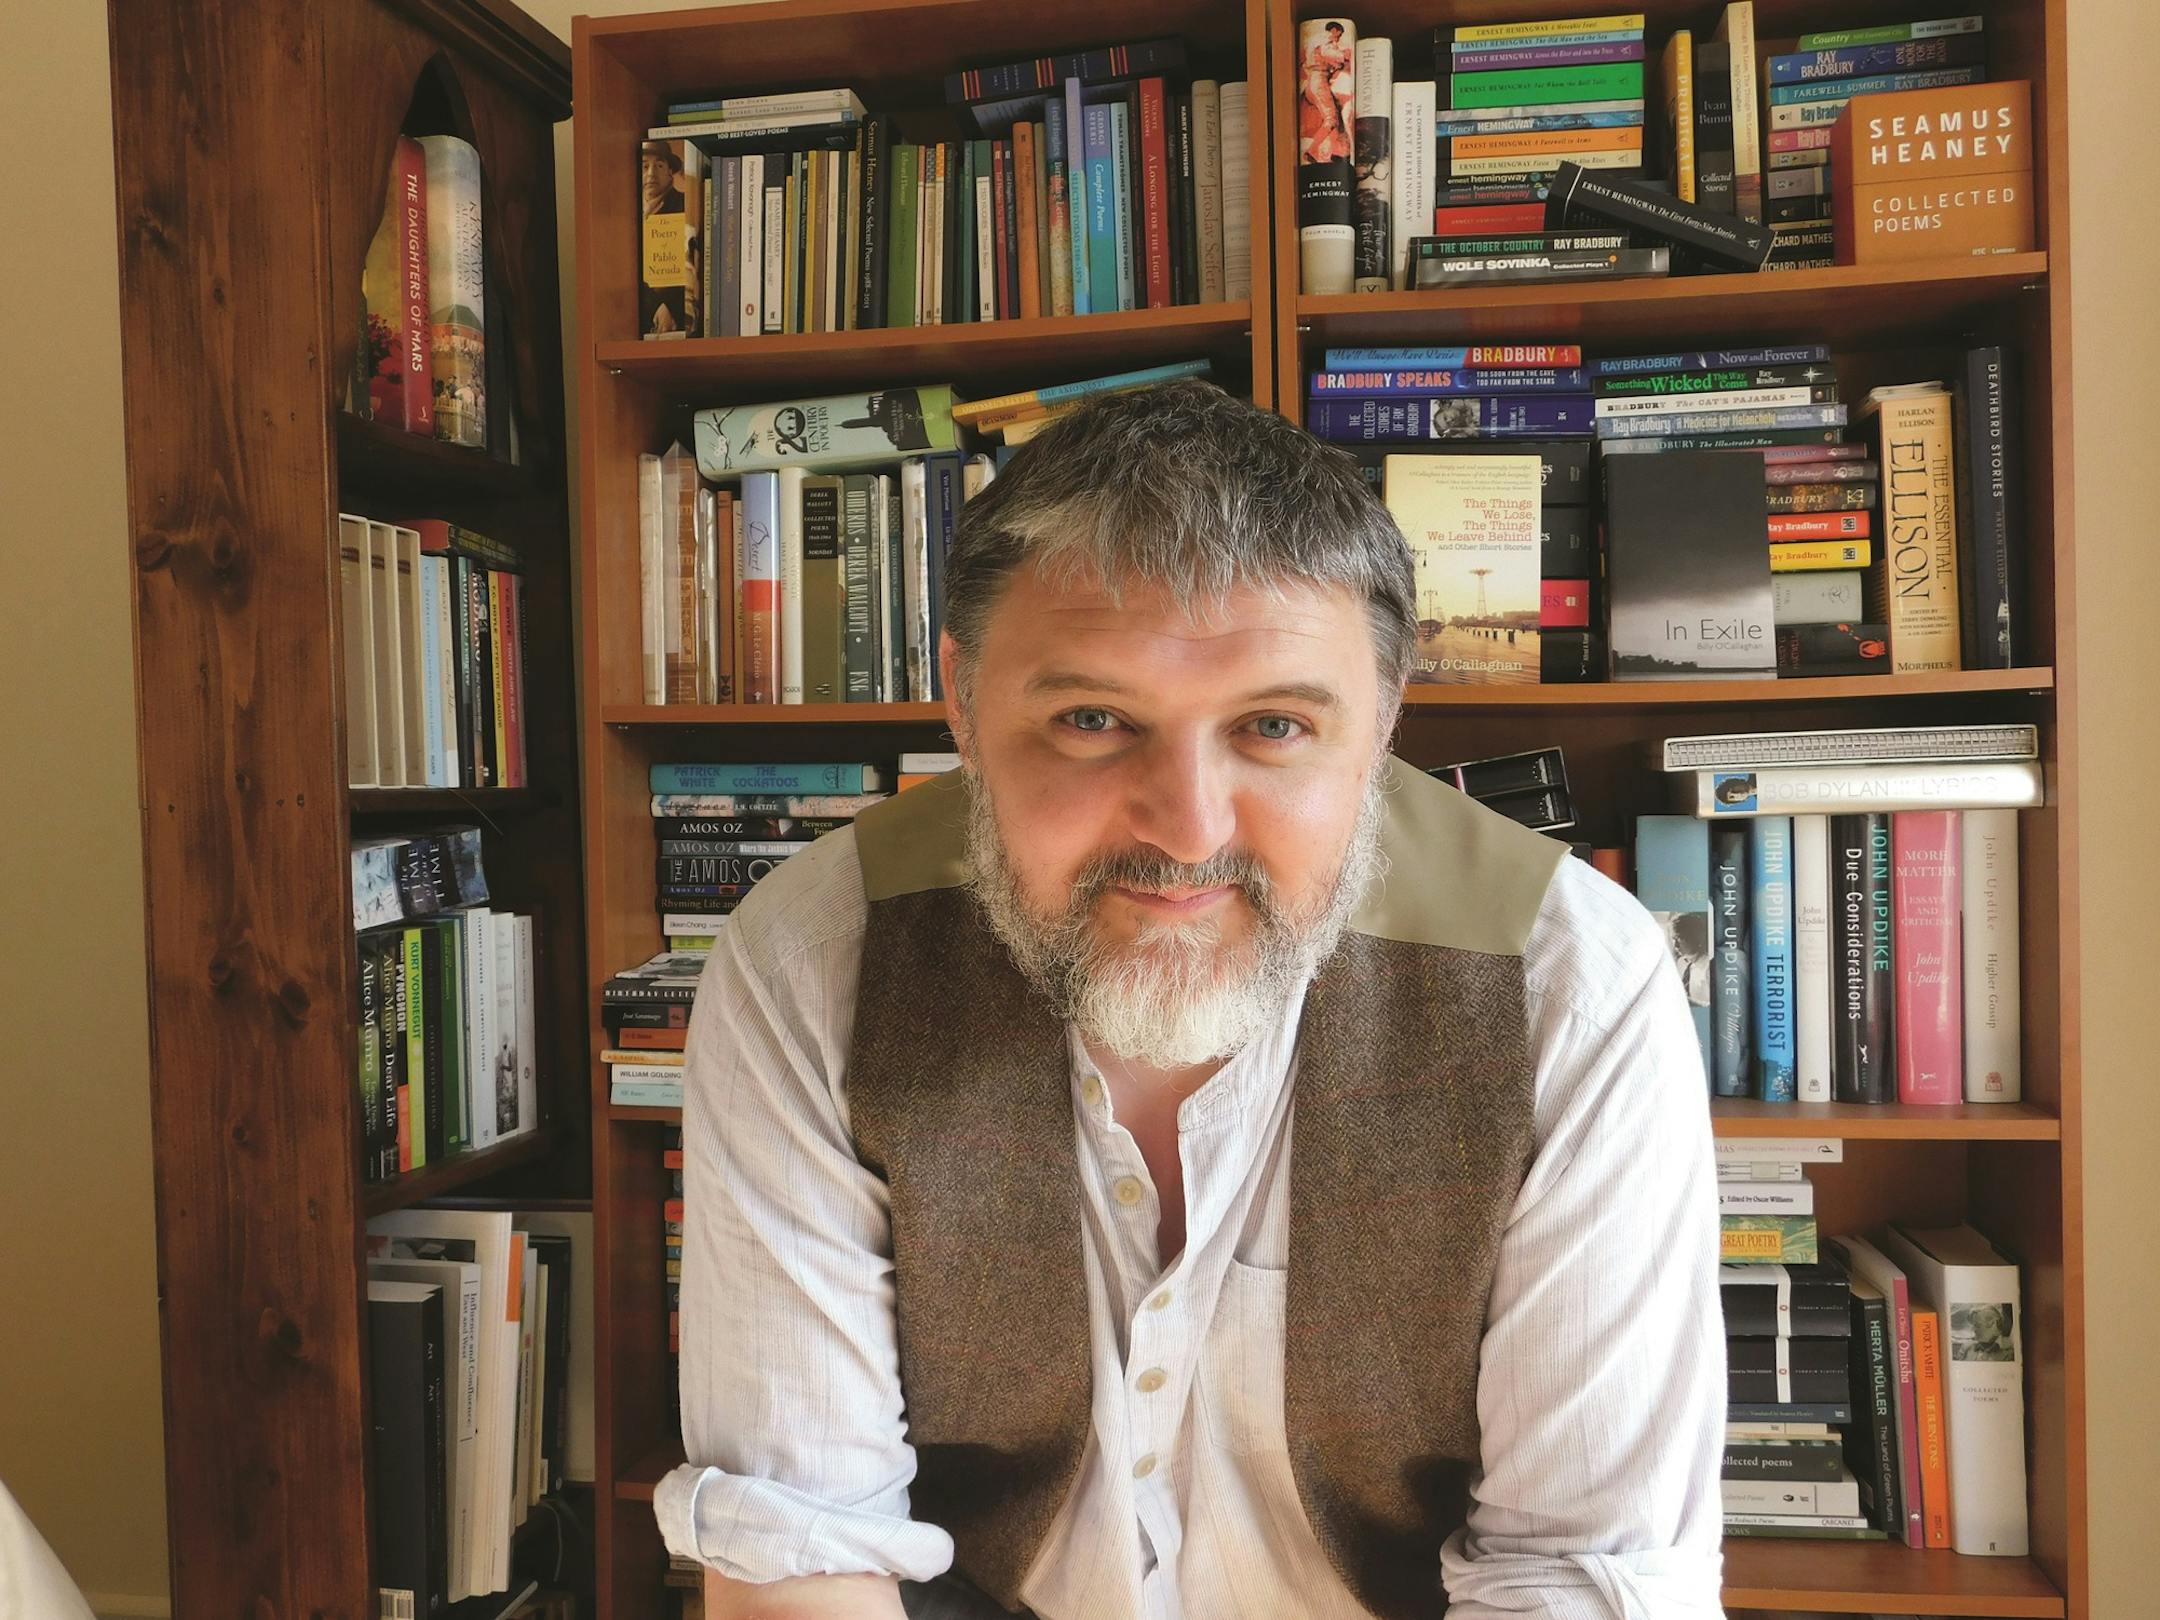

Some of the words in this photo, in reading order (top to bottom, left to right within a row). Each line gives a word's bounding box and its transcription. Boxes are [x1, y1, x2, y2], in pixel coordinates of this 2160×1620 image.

[1506, 24, 1548, 36] HEMINGWAY
[1812, 32, 1850, 46] Country
[1460, 41, 1488, 50] ERNEST
[1490, 38, 1533, 47] HEMINGWAY
[1560, 35, 1574, 43] Man
[1574, 34, 1586, 42] and
[1460, 55, 1488, 64] ERNEST
[1489, 52, 1534, 62] HEMINGWAY
[1816, 50, 1836, 64] RAY
[1895, 46, 1904, 65] ONE
[1800, 60, 1854, 78] BRADBURY
[1360, 50, 1376, 114] HEMINGWAY
[1460, 86, 1488, 94] ERNEST
[1792, 85, 1842, 98] FAREWELL
[1846, 80, 1887, 94] SUMMER
[1894, 78, 1914, 90] RAY
[1917, 72, 1973, 88] BRADBURY
[1703, 100, 1726, 112] Ivan
[1800, 106, 1816, 122] Ray
[767, 127, 789, 136] POEMS
[1477, 119, 1534, 132] HEMINGWAY
[1869, 106, 2012, 138] SEAMUS
[1460, 142, 1488, 150] ERNEST
[1488, 140, 1533, 149] HEMINGWAY
[1540, 138, 1566, 146] Farewell
[1872, 134, 2012, 165] HEANEY
[1148, 154, 1157, 162] A
[1459, 162, 1488, 170] ERNEST
[1488, 160, 1530, 169] HEMINGWAY
[407, 173, 418, 202] THE
[1150, 164, 1158, 208] LONGING
[1310, 180, 1342, 189] ERNEST
[1405, 150, 1414, 222] HEMINGWAY
[1470, 172, 1528, 186] hemingway
[1704, 184, 1728, 192] Stories
[866, 196, 874, 214] New
[1200, 182, 1218, 238] Jaroslav
[1582, 180, 1611, 196] ERNEST
[1612, 190, 1657, 214] HEMINGWAY
[1670, 210, 1684, 224] First
[1715, 226, 1736, 240] Stories
[1874, 188, 2015, 214] COLLECTED
[865, 215, 874, 246] Selected
[1150, 211, 1159, 230] FOR
[1874, 214, 1942, 234] POEMS
[1151, 234, 1159, 251] THE
[1440, 242, 1458, 254] THE
[1459, 240, 1500, 252] OCTOBER
[1502, 239, 1544, 251] COUNTRY
[1553, 238, 1572, 250] RAY
[1574, 236, 1622, 248] BRADBURY
[408, 207, 421, 300] DAUGHTERS
[1204, 242, 1222, 291] Seifert
[1442, 260, 1485, 272] WOLE
[410, 305, 422, 328] OF
[410, 329, 423, 372] MARS
[1472, 348, 1557, 364] BRADBURY
[1718, 353, 1748, 364] Now
[1748, 354, 1764, 362] and
[1764, 350, 1809, 362] Forever
[1317, 372, 1392, 390] BRADBURY
[1396, 371, 1452, 388] SPEAKS
[1503, 378, 1520, 386] FROM
[1605, 380, 1650, 392] Something
[1650, 374, 1713, 392] Wicked
[1756, 376, 1786, 385] Bradbury
[1758, 369, 1772, 378] Ray
[1698, 397, 1728, 406] CAT'S
[1986, 364, 2000, 438] DEATHBIRD
[820, 406, 830, 439] POETRY
[1349, 412, 1361, 426] THE
[1362, 401, 1376, 439] COLLECTED
[1378, 406, 1390, 433] STORIES
[1406, 402, 1420, 436] BRADBURY
[1898, 408, 1935, 417] HARLAN
[807, 406, 818, 453] CENTURY
[1612, 418, 1630, 436] Ray
[1630, 416, 1672, 432] Bradbury
[1682, 416, 1718, 430] Medicine
[1757, 438, 1773, 446] Man
[1932, 455, 1950, 488] THE
[1990, 444, 2004, 498] STORIES
[846, 490, 867, 535] OMEROS
[1463, 498, 1487, 510] The
[1490, 498, 1533, 510] Things
[1482, 510, 1500, 520] We
[1889, 438, 1930, 600] ELLISON
[1426, 530, 1445, 542] We
[1448, 530, 1486, 542] Leave
[1488, 530, 1532, 542] Behind
[1462, 520, 1487, 530] The
[1490, 520, 1533, 532] Things
[1785, 522, 1829, 531] Bradbury
[749, 520, 770, 572] Desert
[1934, 494, 1952, 580] ESSENTIAL
[848, 546, 868, 580] DEREK
[1786, 552, 1828, 560] Bradbury
[848, 583, 868, 634] WALCOTT
[1665, 618, 1688, 640] In
[1700, 618, 1762, 640] Exile
[1440, 658, 1522, 672] O'Callaghan
[674, 766, 721, 776] PATRICK
[755, 766, 776, 776] THE
[679, 777, 716, 788] WHITE
[1764, 782, 1809, 800] BOB
[1818, 780, 1889, 798] DYLAN
[679, 822, 720, 834] AMOS
[722, 822, 744, 834] OZ
[1764, 829, 1784, 873] JOHN
[1872, 823, 1888, 879] JOHN
[1904, 850, 1948, 861] MORE
[1982, 836, 1996, 870] John
[674, 860, 682, 882] THE
[688, 859, 742, 884] AMOS
[1846, 848, 1862, 882] Due
[1896, 866, 1956, 877] MATTER
[1719, 864, 1737, 916] JOHN
[1765, 882, 1784, 946] UPDIKE
[1917, 907, 1938, 915] AND
[1984, 878, 1998, 931] Updike
[1872, 890, 1888, 971] UPDIKE
[410, 941, 420, 972] KURT
[1724, 926, 1738, 996] UPDIKE
[1846, 892, 1864, 1020] Considerations
[1914, 952, 1942, 968] John
[1907, 971, 1950, 987] Updike
[1984, 952, 1999, 990] Higher
[362, 959, 375, 1006] Alice
[605, 990, 658, 998] BIRTHDAY
[1766, 953, 1786, 1050] TERRORIST
[411, 975, 422, 1040] VONNEGUT
[1720, 1002, 1744, 1053] Villages
[364, 1009, 376, 1072] Munro
[385, 1052, 396, 1092] Dear
[619, 1070, 648, 1078] WILLIAM
[650, 1071, 682, 1079] GOLDING
[386, 1096, 396, 1127] Life
[1720, 1232, 1746, 1248] GREAT
[1746, 1233, 1777, 1248] POETRY
[1870, 1320, 1882, 1362] HERTA
[468, 1344, 476, 1362] and
[1898, 1339, 1912, 1384] Onitsha
[1923, 1353, 1934, 1380] WHITE
[1873, 1364, 1888, 1416] MÜLLER
[1880, 1426, 1888, 1440] The
[1881, 1442, 1890, 1461] Land
[1762, 1458, 1792, 1470] poems
[1882, 1462, 1890, 1472] of
[1883, 1473, 1892, 1496] Green
[1885, 1498, 1894, 1522] Plums
